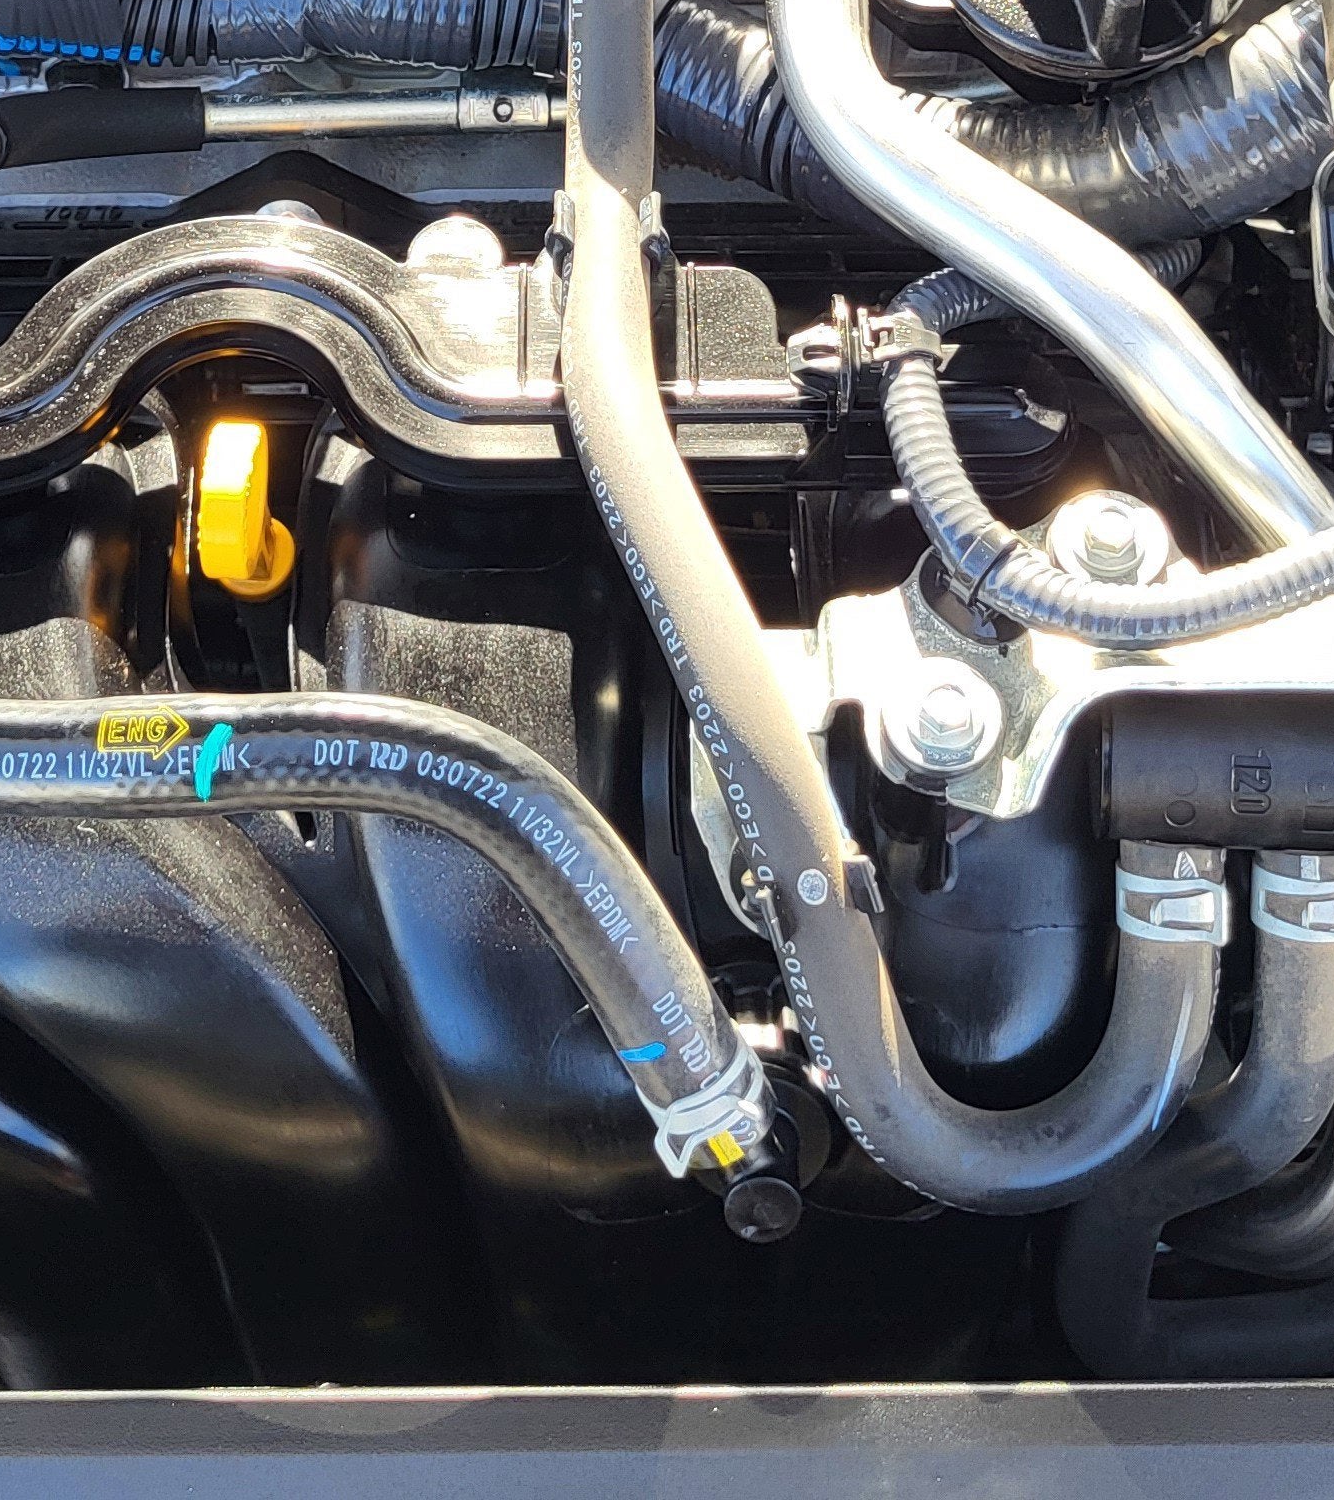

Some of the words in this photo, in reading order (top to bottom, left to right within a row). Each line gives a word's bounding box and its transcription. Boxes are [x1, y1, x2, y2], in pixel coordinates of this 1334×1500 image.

[109, 716, 168, 744] ENG
[314, 738, 360, 768] DOT
[417, 750, 510, 809] 030722
[652, 990, 693, 1037] DOT
